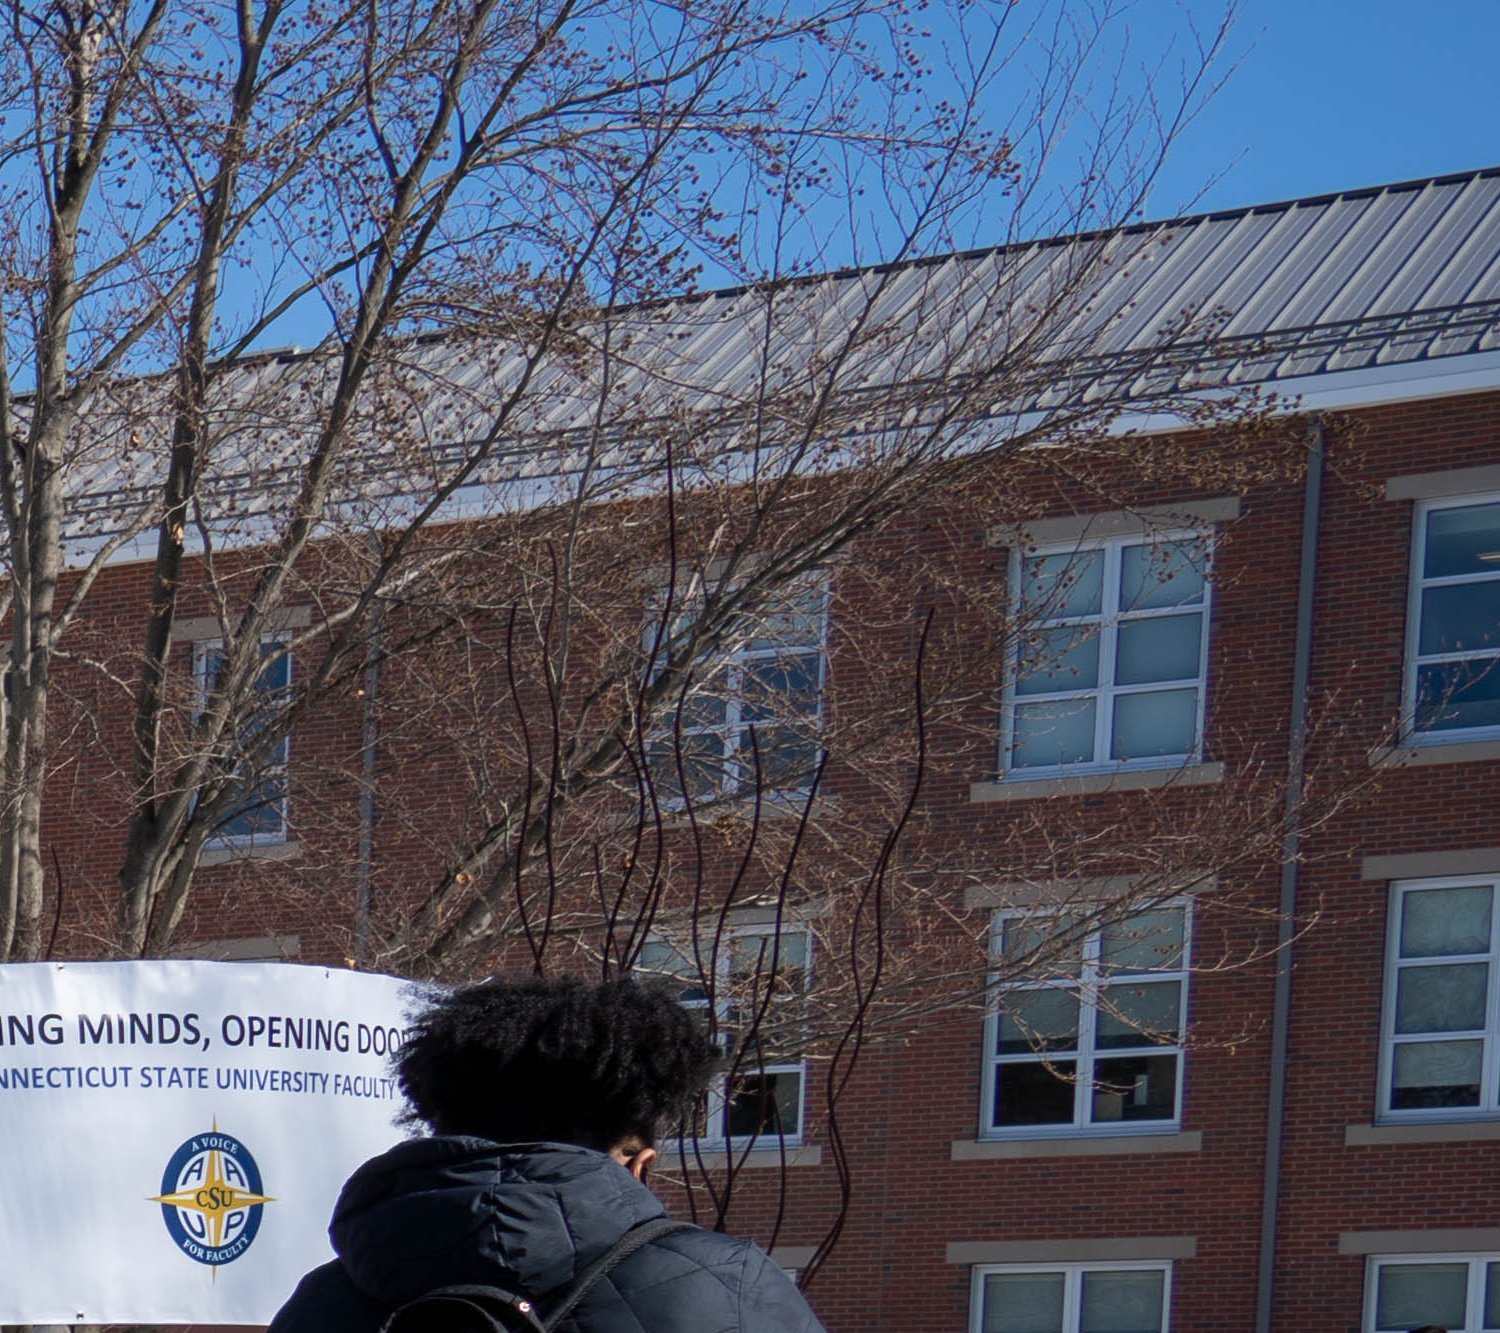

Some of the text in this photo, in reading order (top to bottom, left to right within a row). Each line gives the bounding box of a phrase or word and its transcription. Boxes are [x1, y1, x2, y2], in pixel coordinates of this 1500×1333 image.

[78, 1013, 212, 1053] MINDS,
[221, 1014, 349, 1053] OPENING
[139, 1066, 210, 1091] STATE
[215, 1068, 329, 1096] UNIVERSITY
[334, 1073, 396, 1100] FACULTY
[191, 1136, 239, 1154] A VOICE
[196, 1186, 235, 1210] CSU
[183, 1233, 250, 1262] FOR FACULTY
